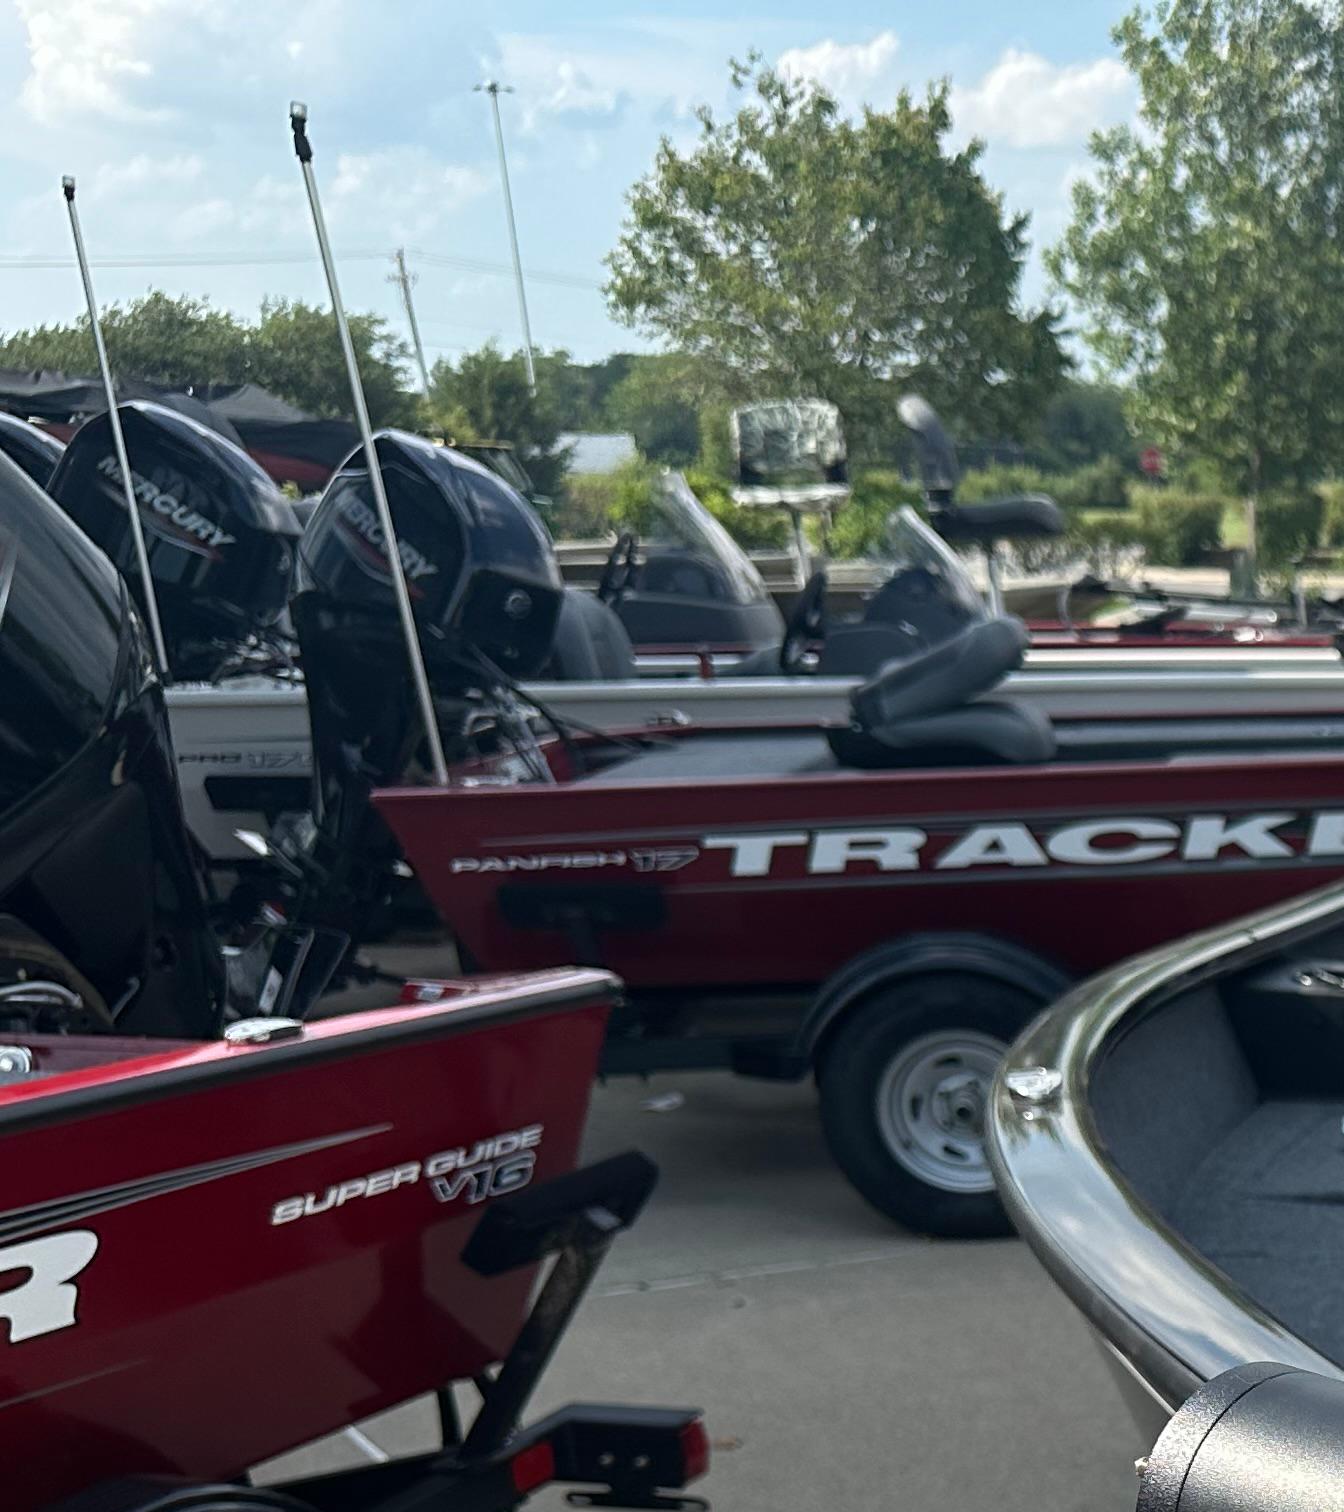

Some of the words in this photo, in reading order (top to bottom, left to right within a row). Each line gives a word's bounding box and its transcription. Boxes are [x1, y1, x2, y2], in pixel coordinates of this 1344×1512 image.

[270, 1160, 422, 1226] SUPER
[424, 1123, 545, 1178] GUIDE
[428, 1149, 537, 1205] V16
